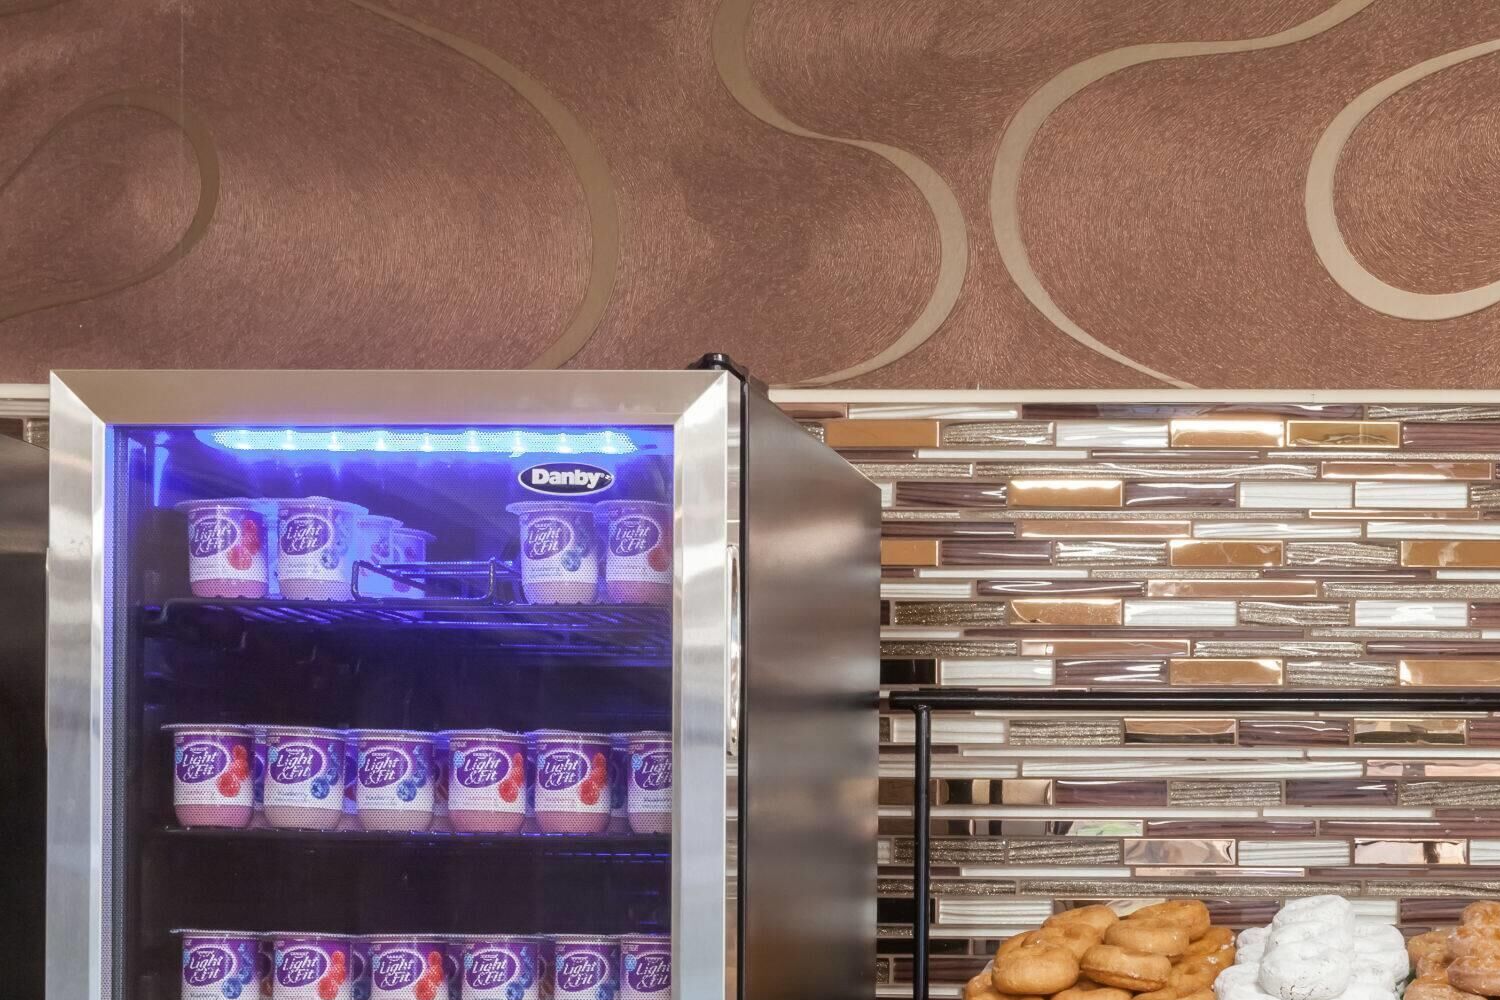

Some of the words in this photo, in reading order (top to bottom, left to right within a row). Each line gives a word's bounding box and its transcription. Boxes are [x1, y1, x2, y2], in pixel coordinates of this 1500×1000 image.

[531, 468, 601, 489] Danby
[286, 525, 323, 541] Light
[528, 526, 562, 544] Light
[615, 525, 650, 541] Light
[182, 750, 217, 767] Light
[276, 752, 314, 768] Light
[364, 755, 400, 772] Light
[464, 756, 501, 773] Light
[544, 758, 579, 774] Light
[642, 758, 672, 774] Ligh
[189, 954, 224, 970] Light
[282, 955, 318, 972] Light
[379, 957, 415, 974] Light
[472, 958, 508, 974] Light
[563, 959, 598, 976] Light
[635, 960, 671, 976] Light
